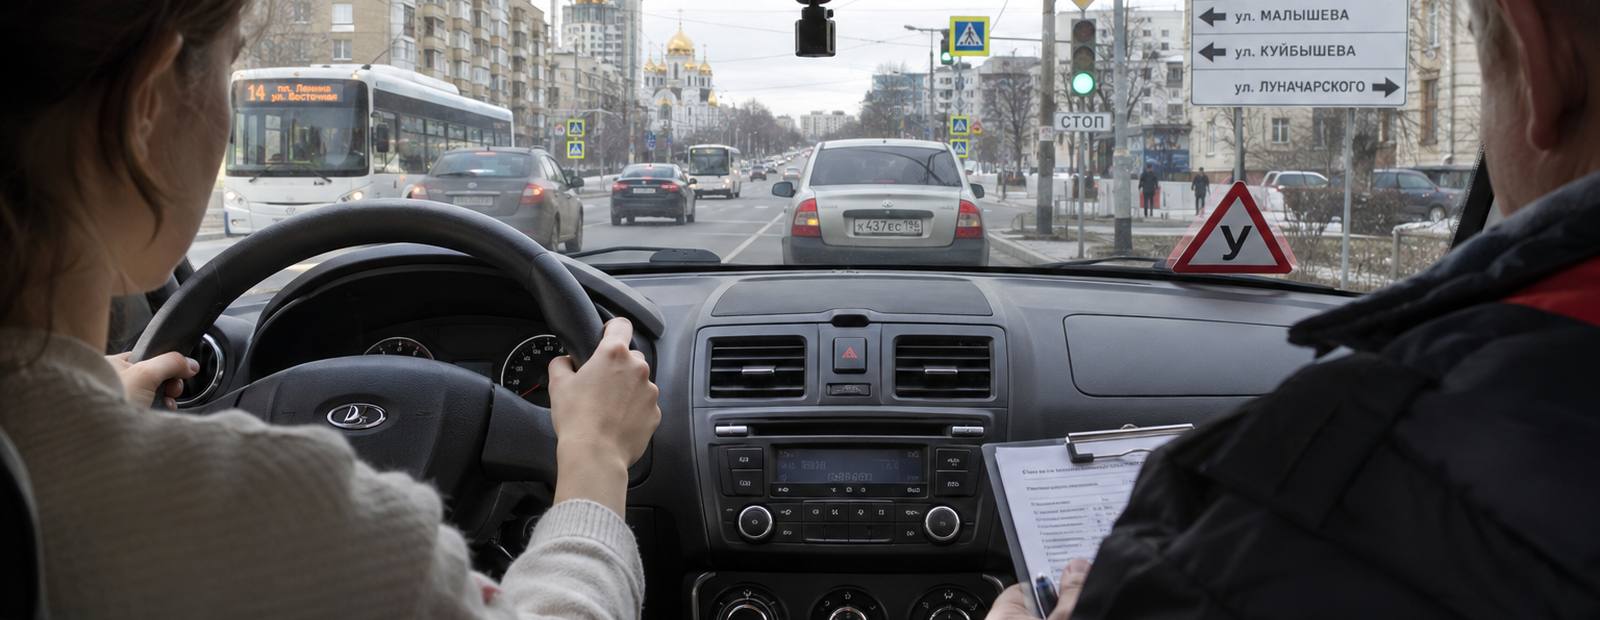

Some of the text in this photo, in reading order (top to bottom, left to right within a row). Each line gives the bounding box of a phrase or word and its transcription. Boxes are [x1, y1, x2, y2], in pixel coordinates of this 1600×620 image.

[1235, 9, 1350, 24] ул. МАЛЫШЕВА
[1235, 43, 1356, 60] ул. КУЙБЫШЕВА
[247, 84, 266, 101] 14
[1234, 81, 1366, 96] ул. ЛУНАЧАРСКОГО
[1061, 115, 1105, 129] СТОП
[1220, 225, 1253, 261] У
